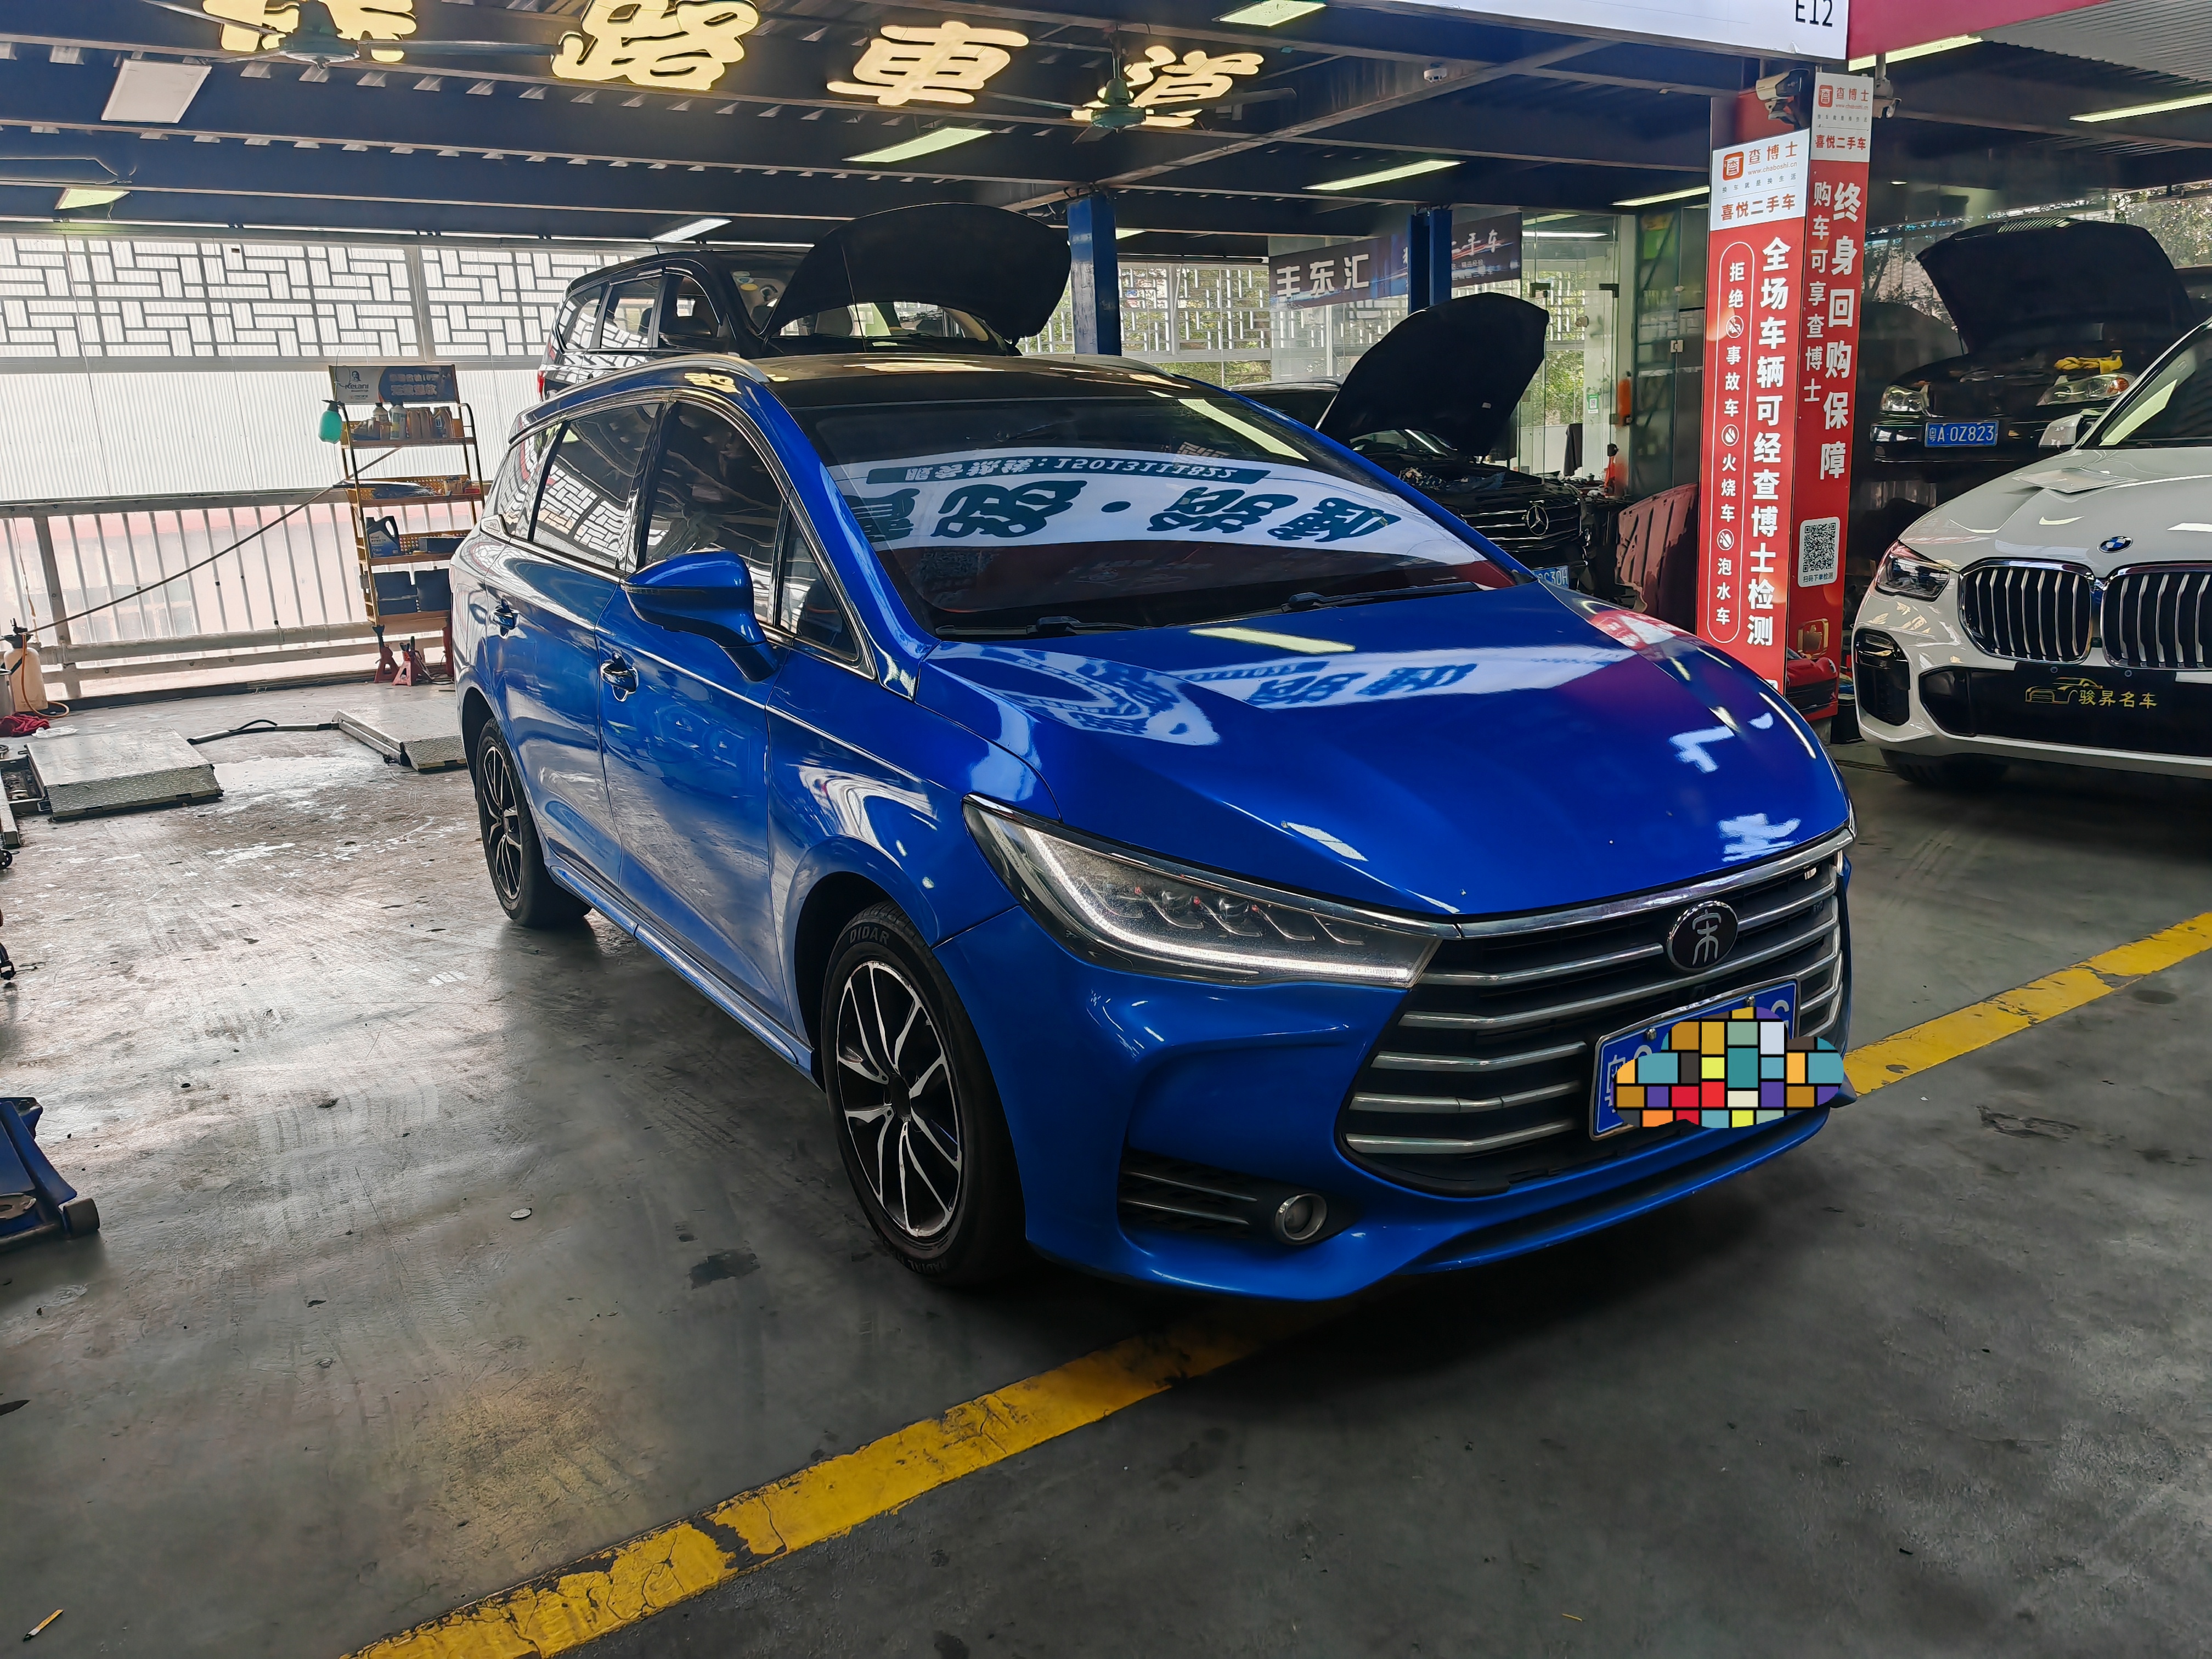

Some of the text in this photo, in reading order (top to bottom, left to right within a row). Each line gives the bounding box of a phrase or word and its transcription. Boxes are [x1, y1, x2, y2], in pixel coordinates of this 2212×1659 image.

[1795, 0, 1833, 27] E12
[1836, 87, 1869, 101] 查博士
[1748, 141, 1798, 165] 查博士
[1815, 134, 1866, 150] 喜悦二手车
[1748, 161, 1797, 176] www.chaboshi.cn
[1721, 194, 1796, 221] 喜悦二手车
[1276, 253, 1370, 298] 丰东汇
[1803, 182, 1831, 403] 购车可享查博士
[1820, 181, 1862, 481] 终身回购保障
[1716, 262, 1745, 625] 拒绝 事故车 火烧车 泡水车
[1747, 236, 1792, 647] 全场车辆可经查博士检测
[1803, 572, 1833, 583] 扫码下单检测
[2079, 690, 2158, 709] 骏昇名车
